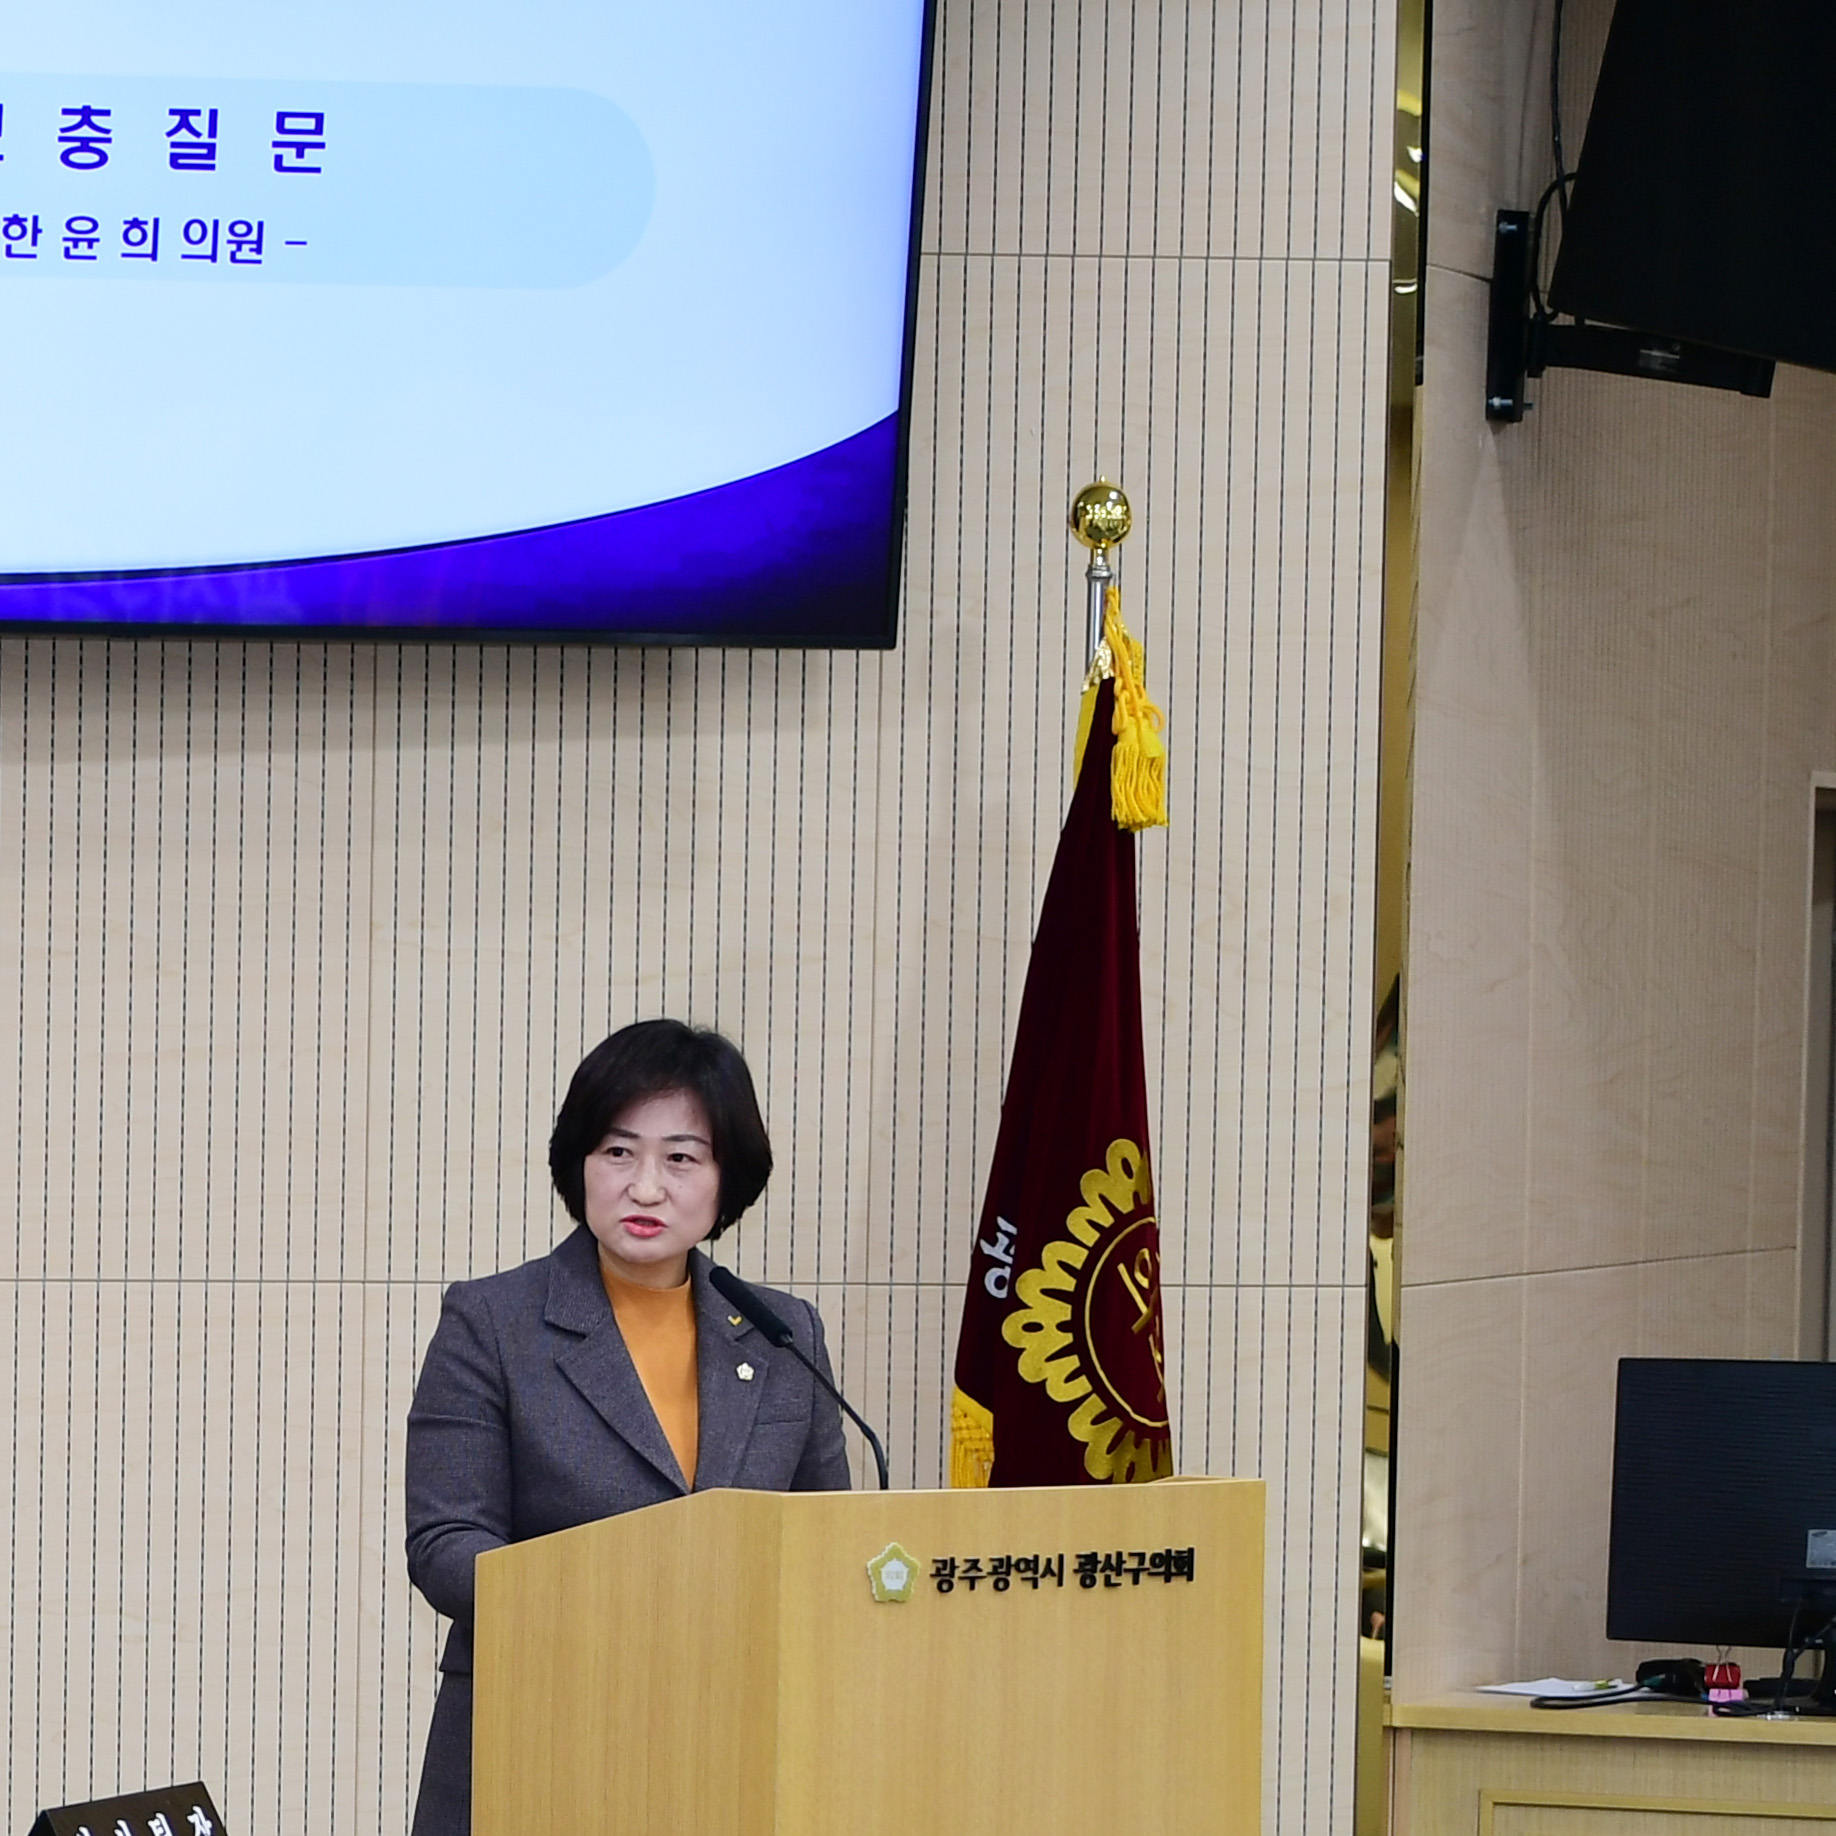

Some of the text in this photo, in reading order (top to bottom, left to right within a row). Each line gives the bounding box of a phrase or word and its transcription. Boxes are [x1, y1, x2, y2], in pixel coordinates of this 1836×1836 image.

[179, 217, 266, 266] 의원
[928, 1546, 1196, 1595] 광주광역시 광산구의회
